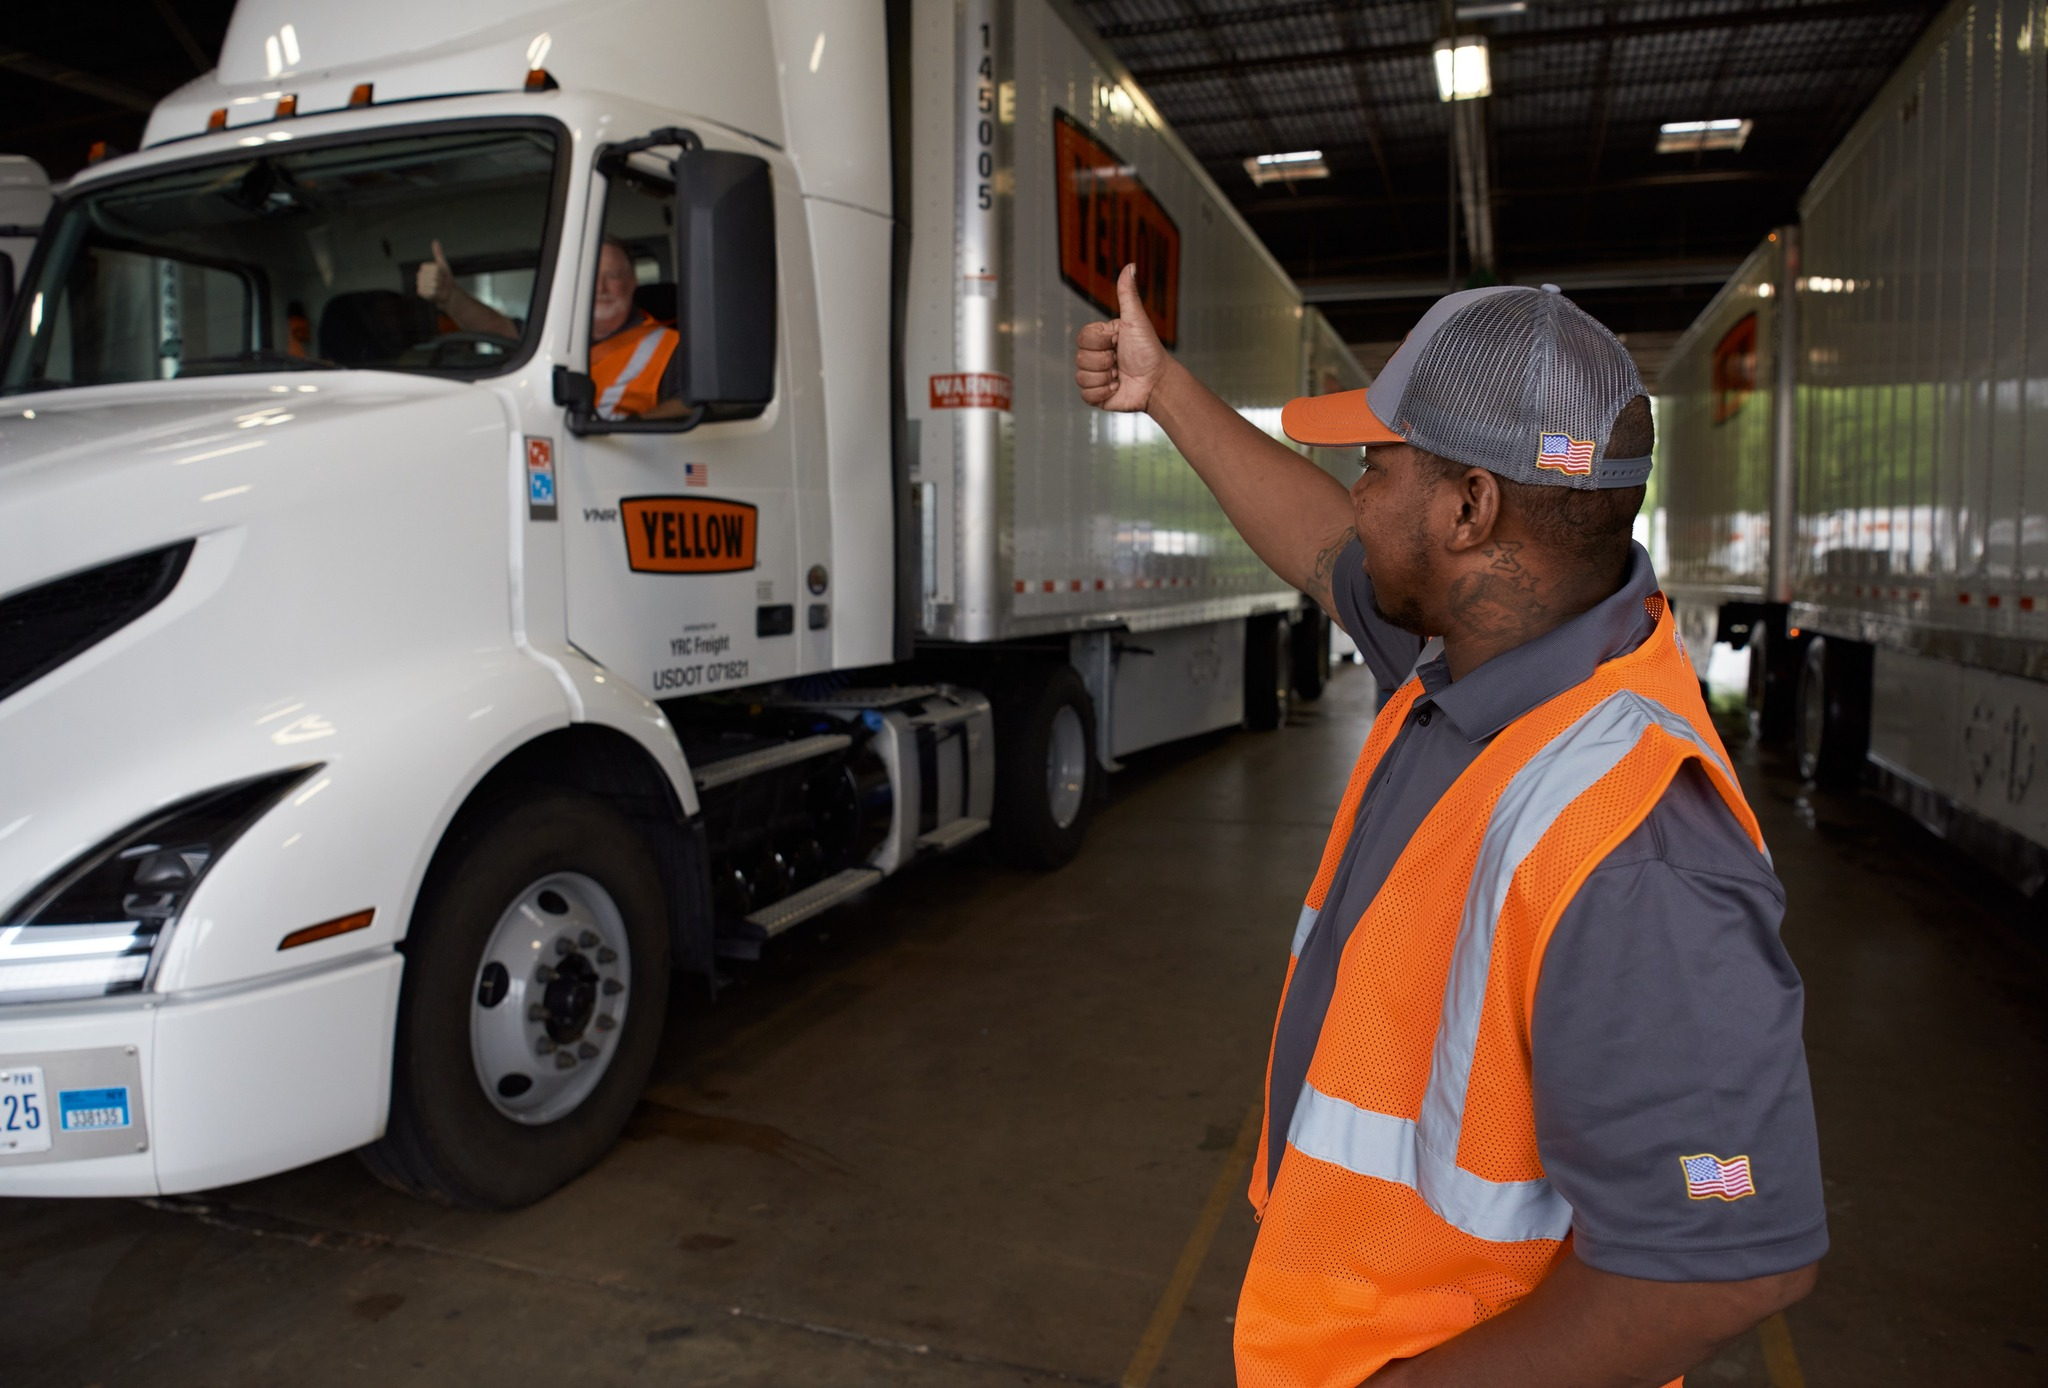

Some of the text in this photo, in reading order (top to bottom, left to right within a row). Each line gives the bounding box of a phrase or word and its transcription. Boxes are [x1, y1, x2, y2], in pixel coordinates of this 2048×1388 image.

[978, 23, 993, 211] 145005
[641, 511, 744, 559] YELLOW
[670, 635, 730, 656] YRC Freight
[653, 665, 704, 691] USDOT
[0, 1093, 40, 1131] 25
